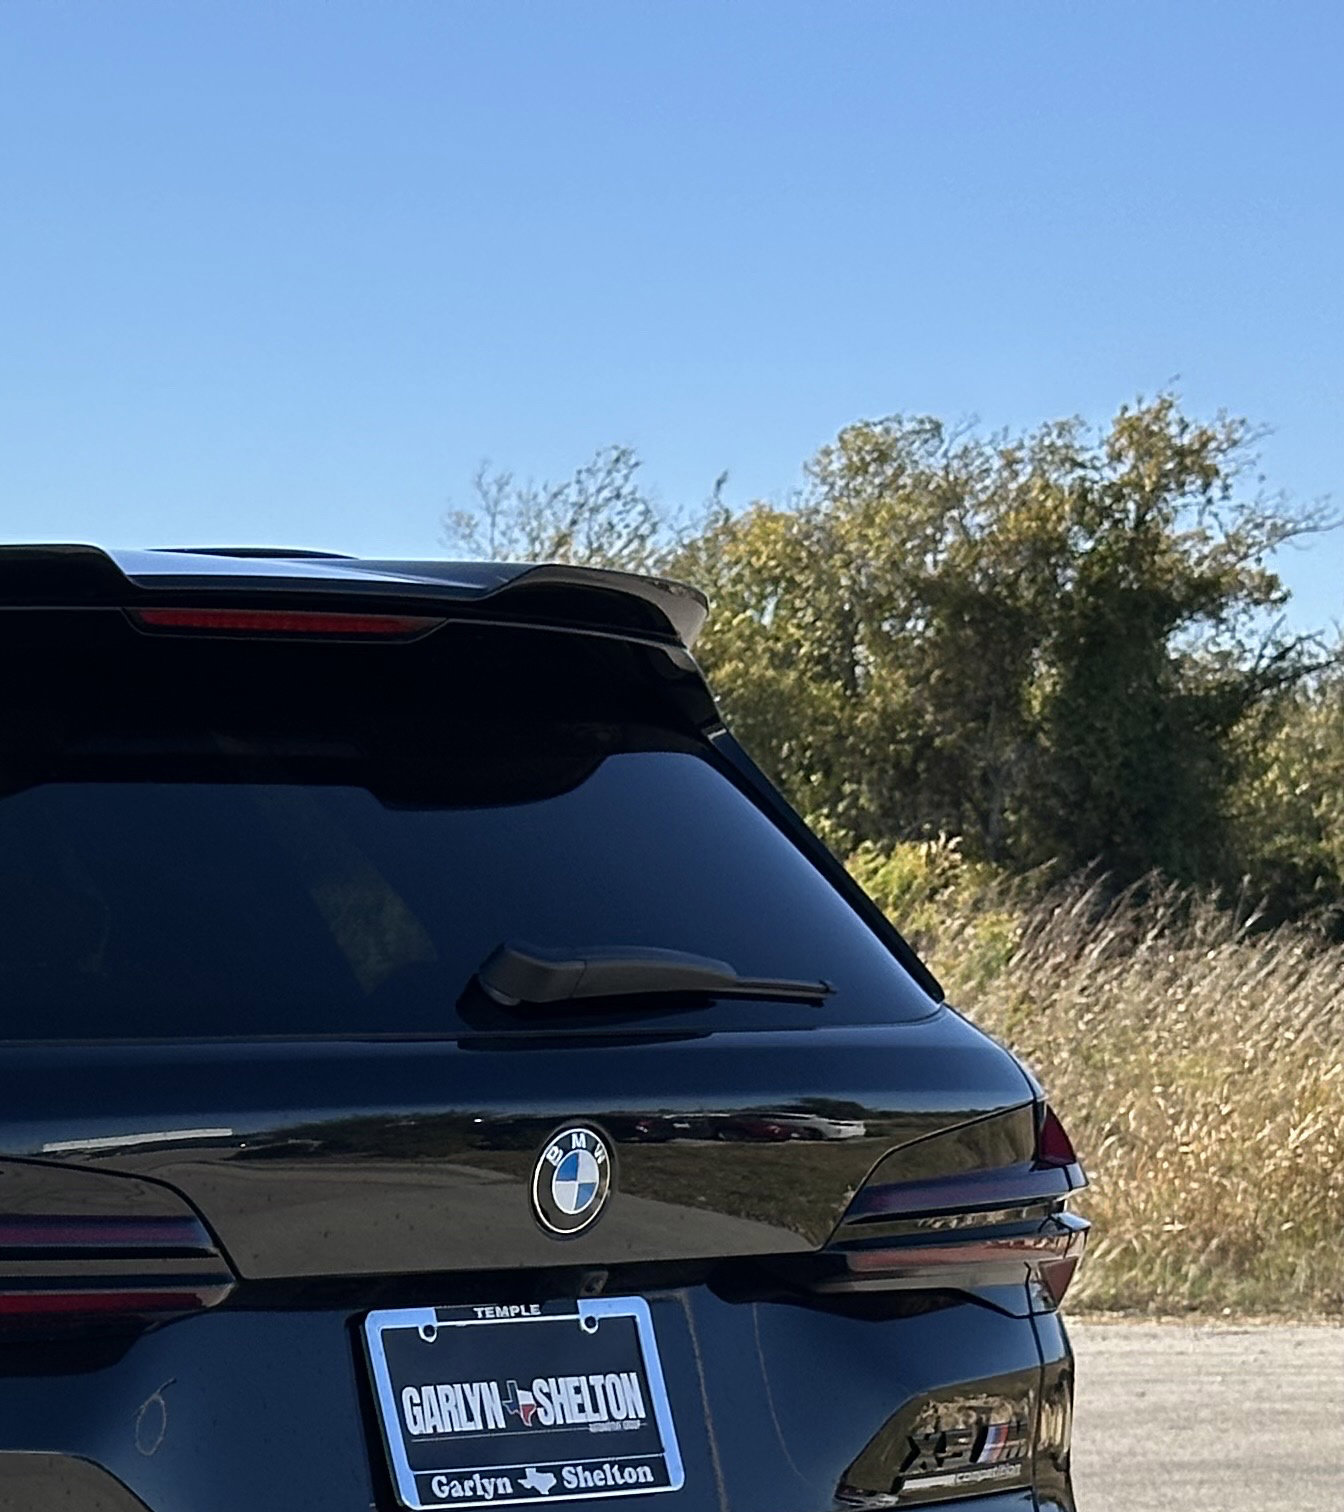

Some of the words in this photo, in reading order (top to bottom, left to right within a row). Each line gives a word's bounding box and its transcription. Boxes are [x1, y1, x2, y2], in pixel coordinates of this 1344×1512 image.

[545, 1132, 606, 1167] BMW
[472, 1303, 541, 1319] TEMPLE
[402, 1380, 506, 1435] GARLYN
[531, 1371, 646, 1426] SHELTON
[430, 1472, 514, 1500] Garlyn
[560, 1462, 654, 1489] Shelton
